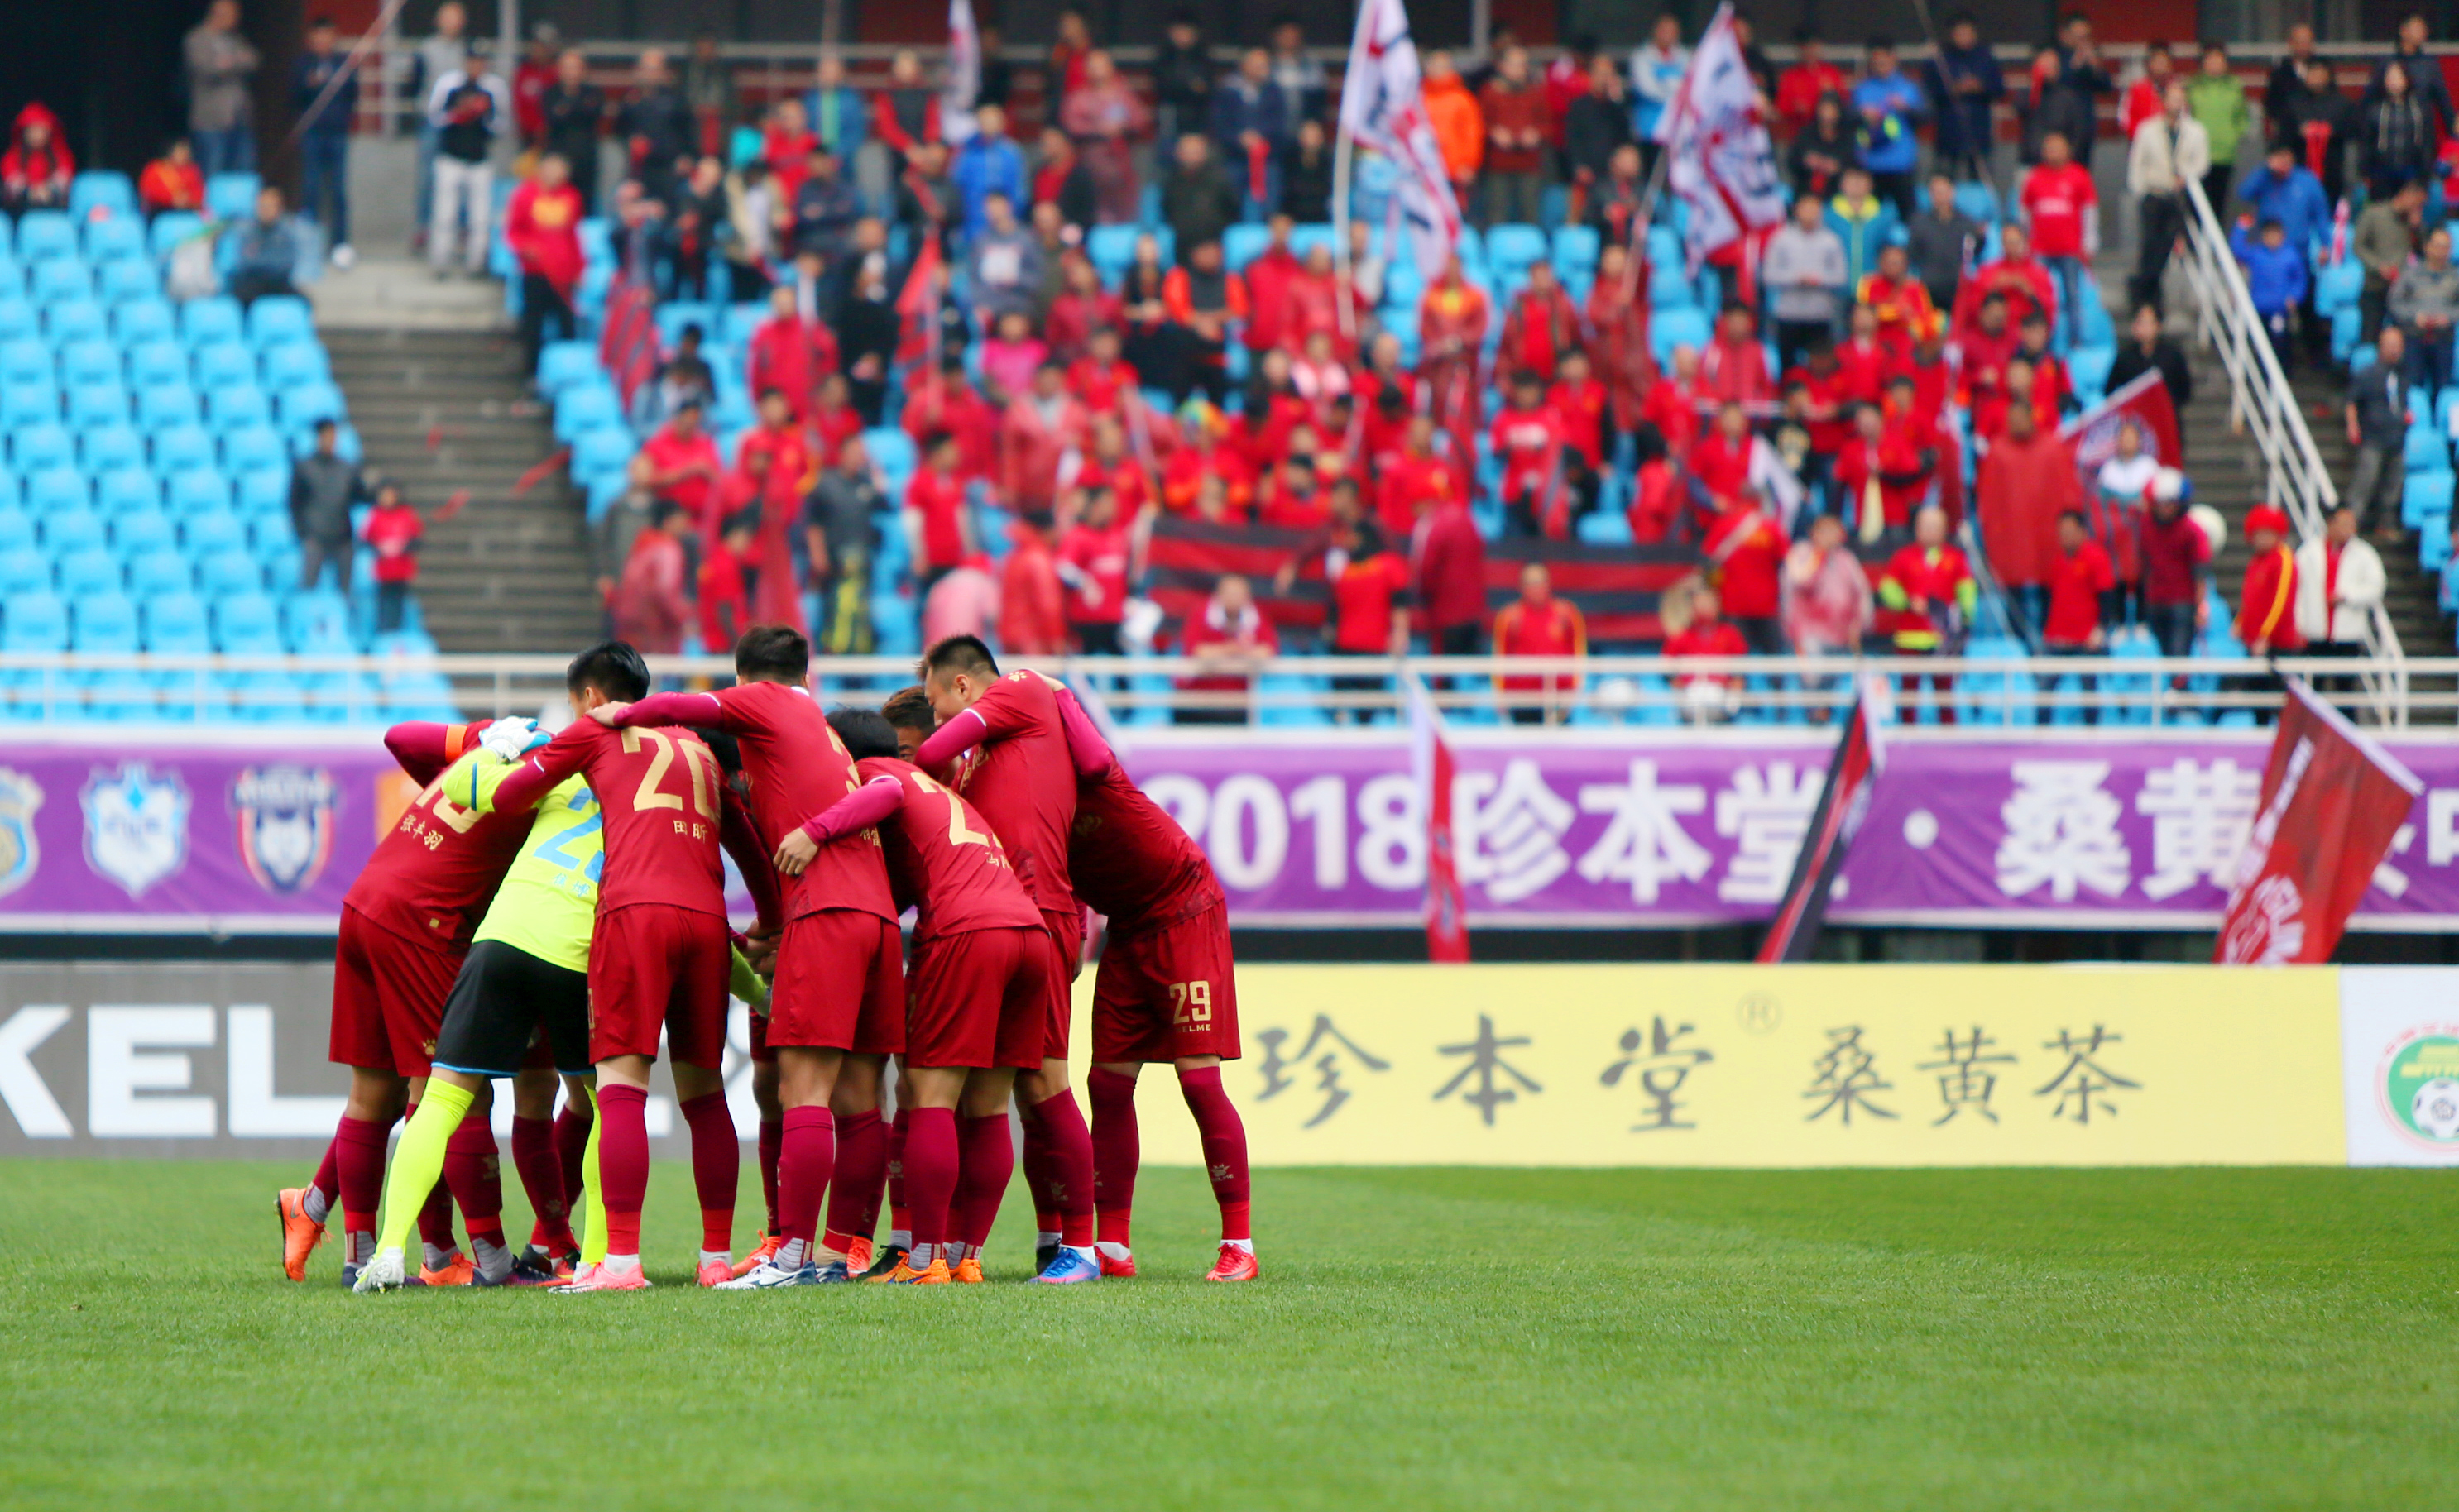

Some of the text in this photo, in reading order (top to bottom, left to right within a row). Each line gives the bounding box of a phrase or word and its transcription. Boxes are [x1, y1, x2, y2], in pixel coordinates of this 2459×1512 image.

[621, 725, 721, 830] 20
[910, 771, 1003, 849] 2
[400, 814, 444, 851] 张丰羽
[533, 787, 606, 883] 2
[673, 819, 708, 844] 田昕
[1168, 980, 1212, 1024] 29
[1254, 1012, 2144, 1133] 珍本堂 桑黄茶
